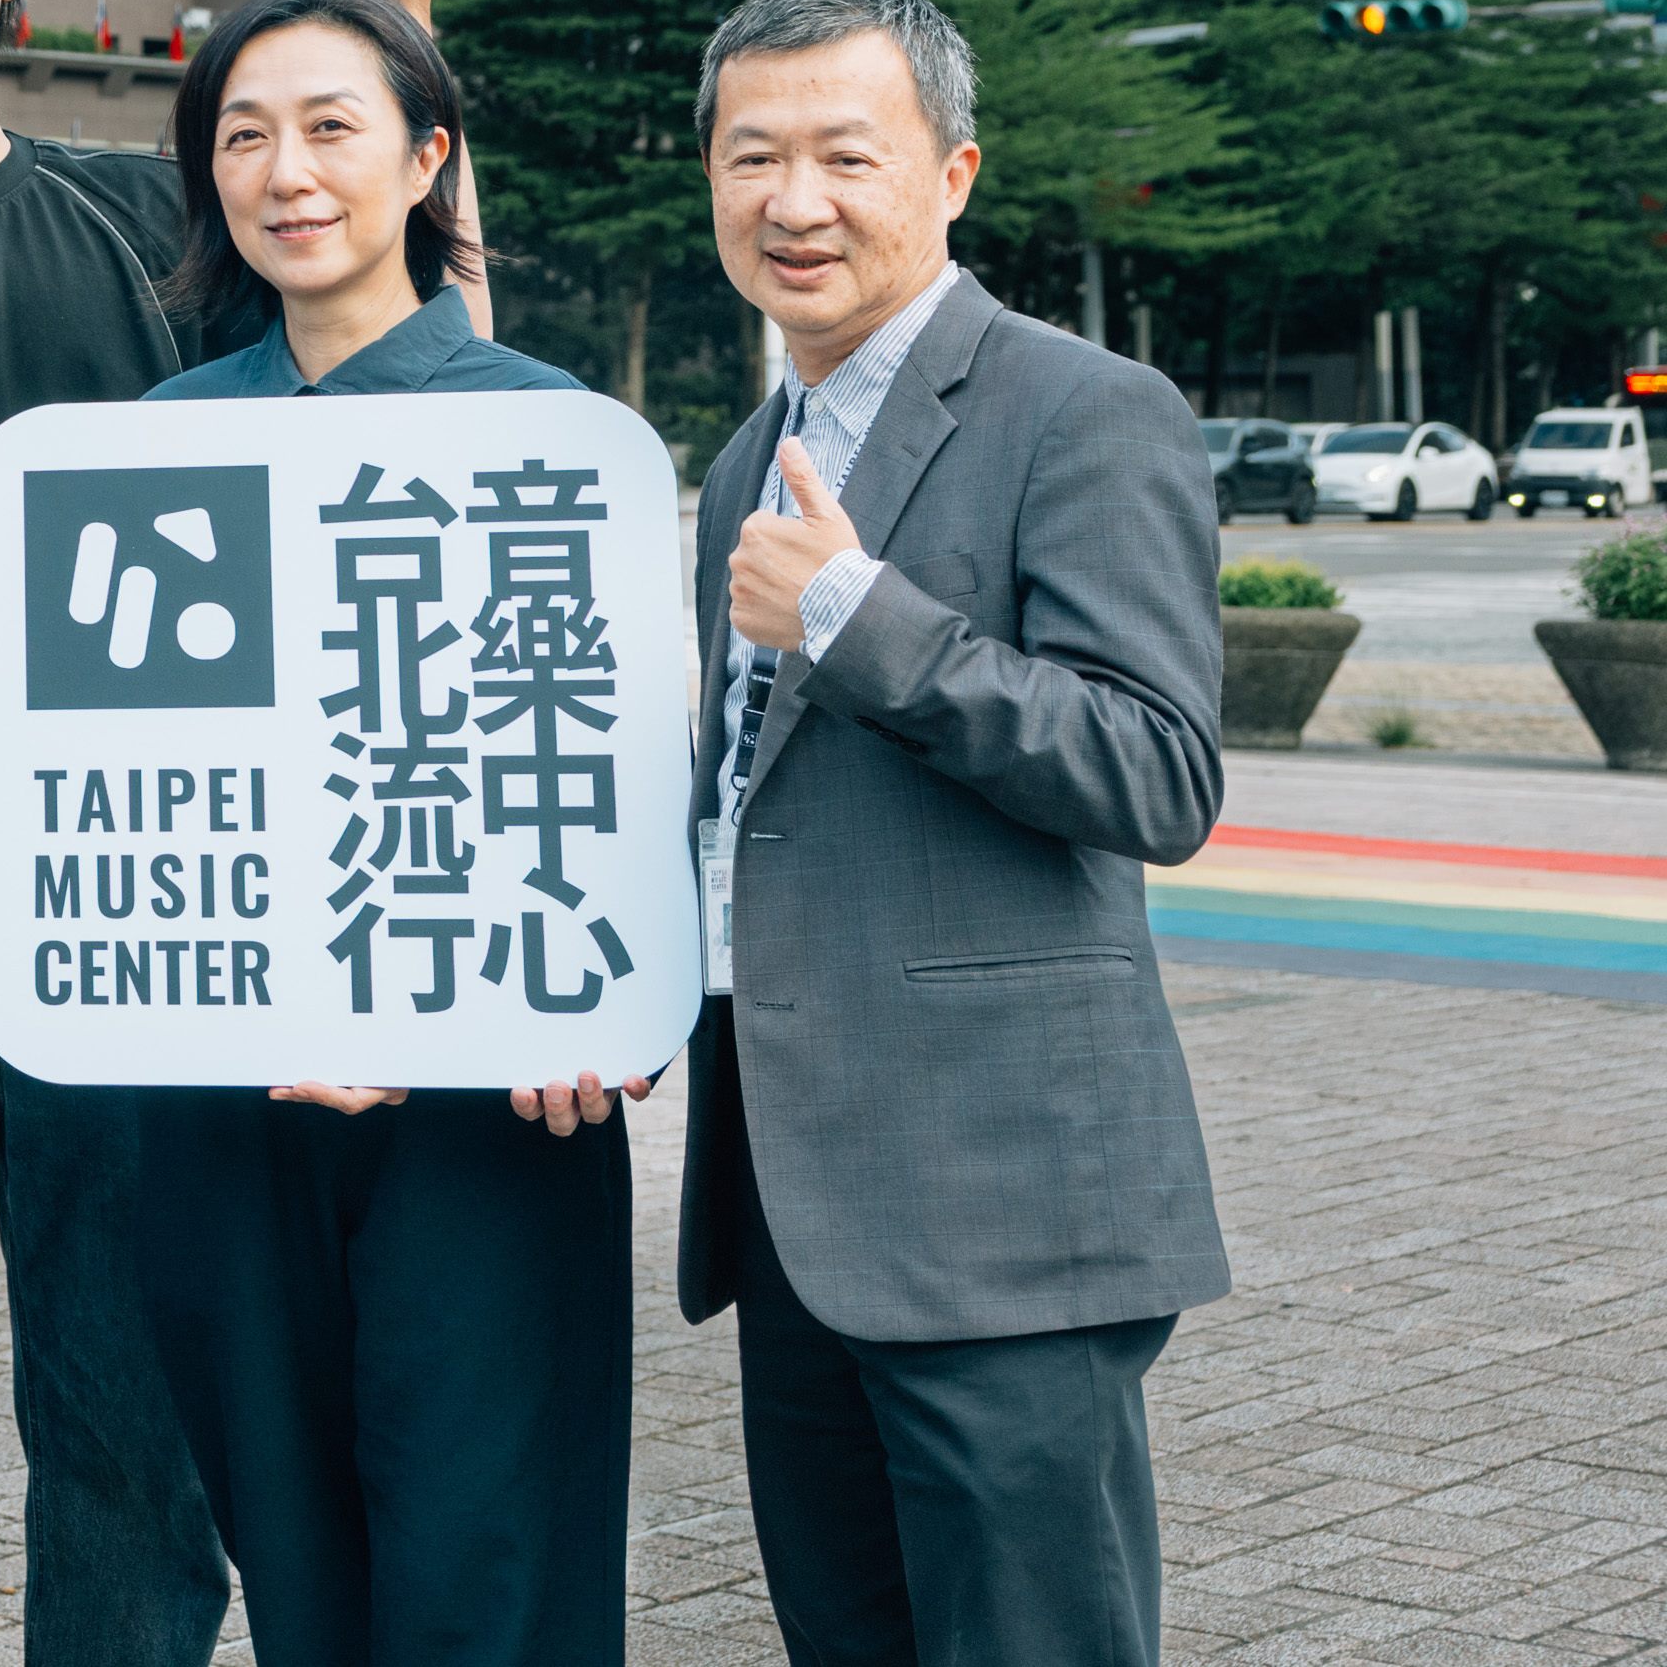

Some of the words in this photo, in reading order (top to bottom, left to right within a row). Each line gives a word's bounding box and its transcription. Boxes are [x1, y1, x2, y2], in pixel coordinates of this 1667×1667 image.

[319, 463, 476, 1015] 台北流行
[467, 459, 635, 1015] 音樂中心
[34, 768, 267, 834] TAIPEI
[35, 853, 271, 920] MUSIC
[34, 940, 273, 1008] CENTER
